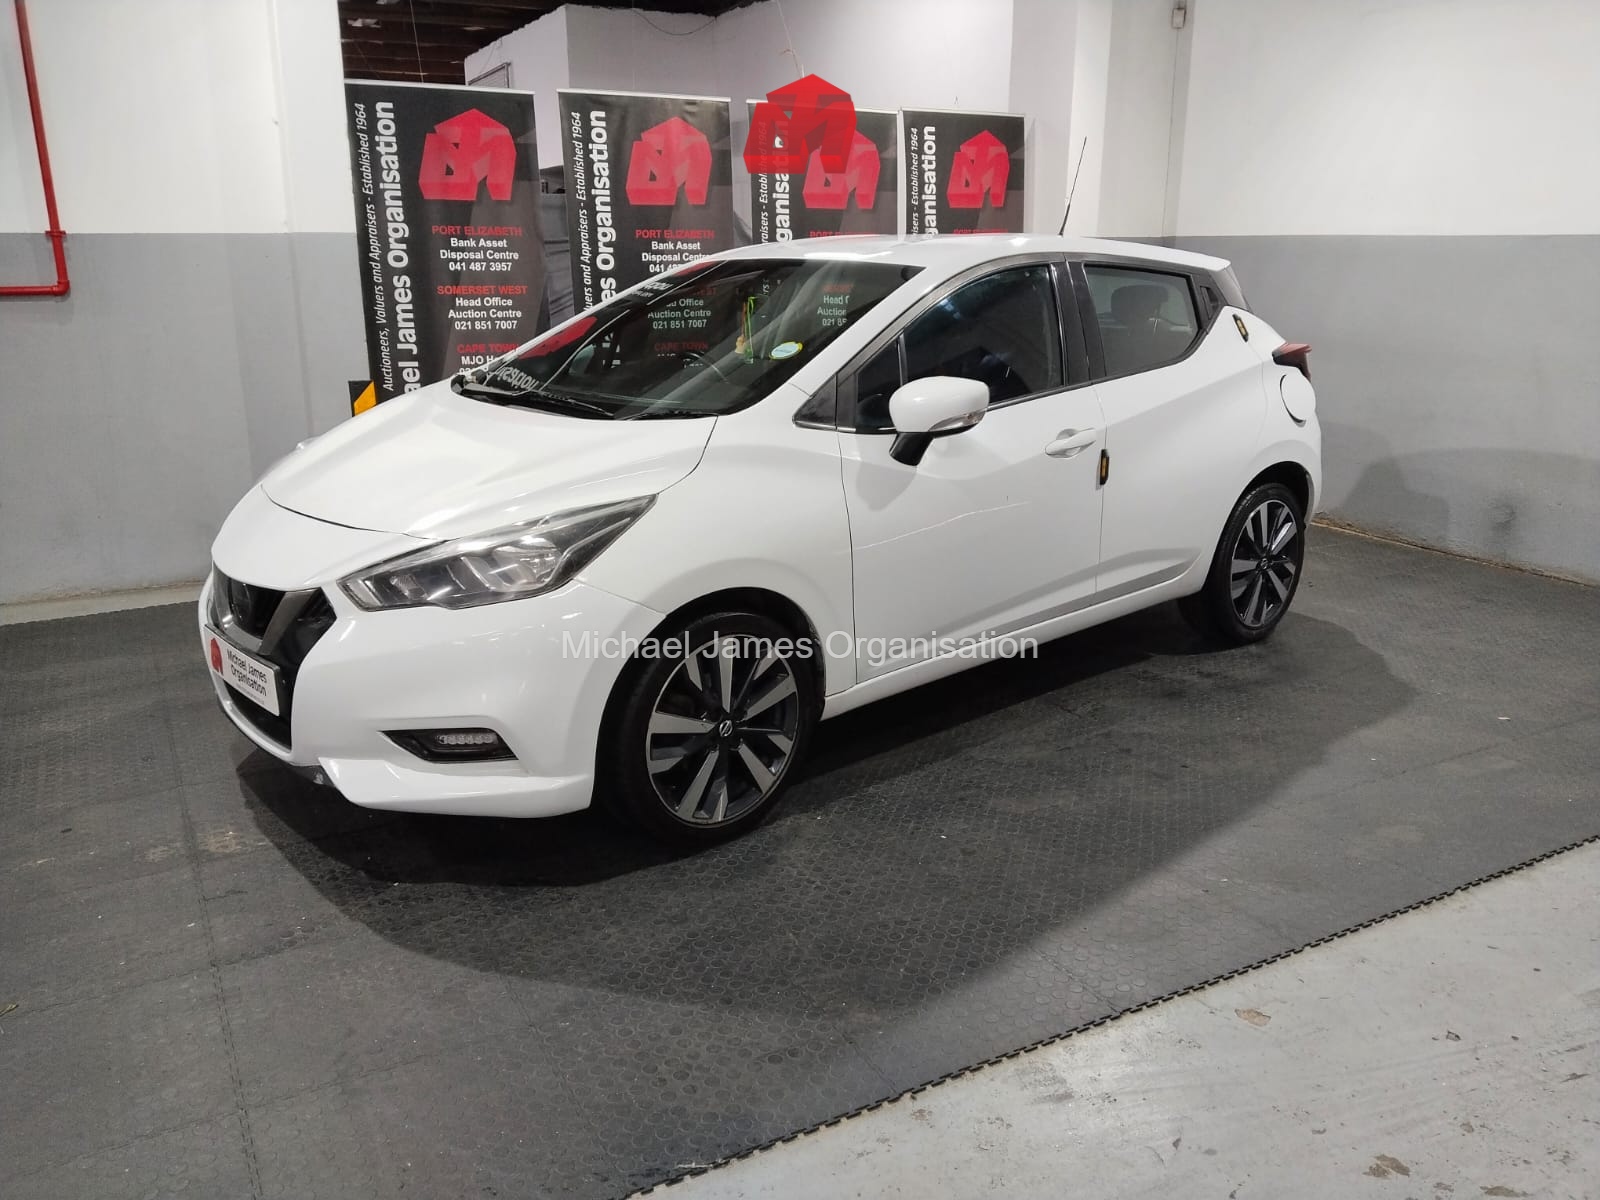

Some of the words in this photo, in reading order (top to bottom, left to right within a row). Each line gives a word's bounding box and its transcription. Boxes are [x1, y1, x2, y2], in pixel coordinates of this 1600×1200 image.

[354, 102, 367, 130] 1964
[571, 112, 582, 137] 1964
[910, 128, 918, 150] 1964
[356, 132, 374, 195] Established
[572, 140, 586, 200] Established
[910, 152, 919, 206] Established
[365, 203, 381, 260] Appraisers
[432, 225, 462, 235] PORT
[464, 226, 523, 236] ELIZABETH
[636, 229, 661, 239] PORT
[664, 230, 715, 239] ELIZABETH
[578, 209, 592, 263] Appraisers
[450, 238, 476, 247] Bank
[479, 238, 507, 248] Asset
[651, 241, 674, 250] Bank
[676, 241, 701, 249] Asset
[440, 250, 484, 260] Disposal
[486, 250, 519, 260] Centre
[642, 253, 680, 263] Disposal
[449, 262, 466, 271] 041
[469, 262, 486, 271] 487
[490, 262, 512, 271] 3957
[649, 264, 664, 273] 041
[369, 261, 383, 283] and
[580, 264, 592, 285] and
[437, 285, 496, 295] SOMERSET
[498, 286, 528, 295] WEST
[374, 285, 387, 324] Valuers
[455, 298, 481, 307] Head
[484, 297, 513, 306] Office
[679, 298, 704, 307] Office
[823, 295, 843, 304] Head
[392, 275, 418, 355] James
[448, 309, 487, 319] Auction
[489, 309, 522, 318] Centre
[647, 310, 681, 319] Auction
[683, 309, 711, 318] Centre
[455, 321, 472, 330] 021
[475, 321, 492, 330] 851
[495, 320, 517, 330] 7007
[652, 321, 668, 329] 021
[670, 320, 685, 329] 851
[688, 319, 707, 328] 7007
[457, 343, 486, 353] CAPE
[379, 328, 394, 391] Auctioneers,
[461, 355, 484, 365] MJO
[227, 648, 247, 671] Michael
[248, 662, 267, 683] James
[231, 664, 267, 697] Organisation
